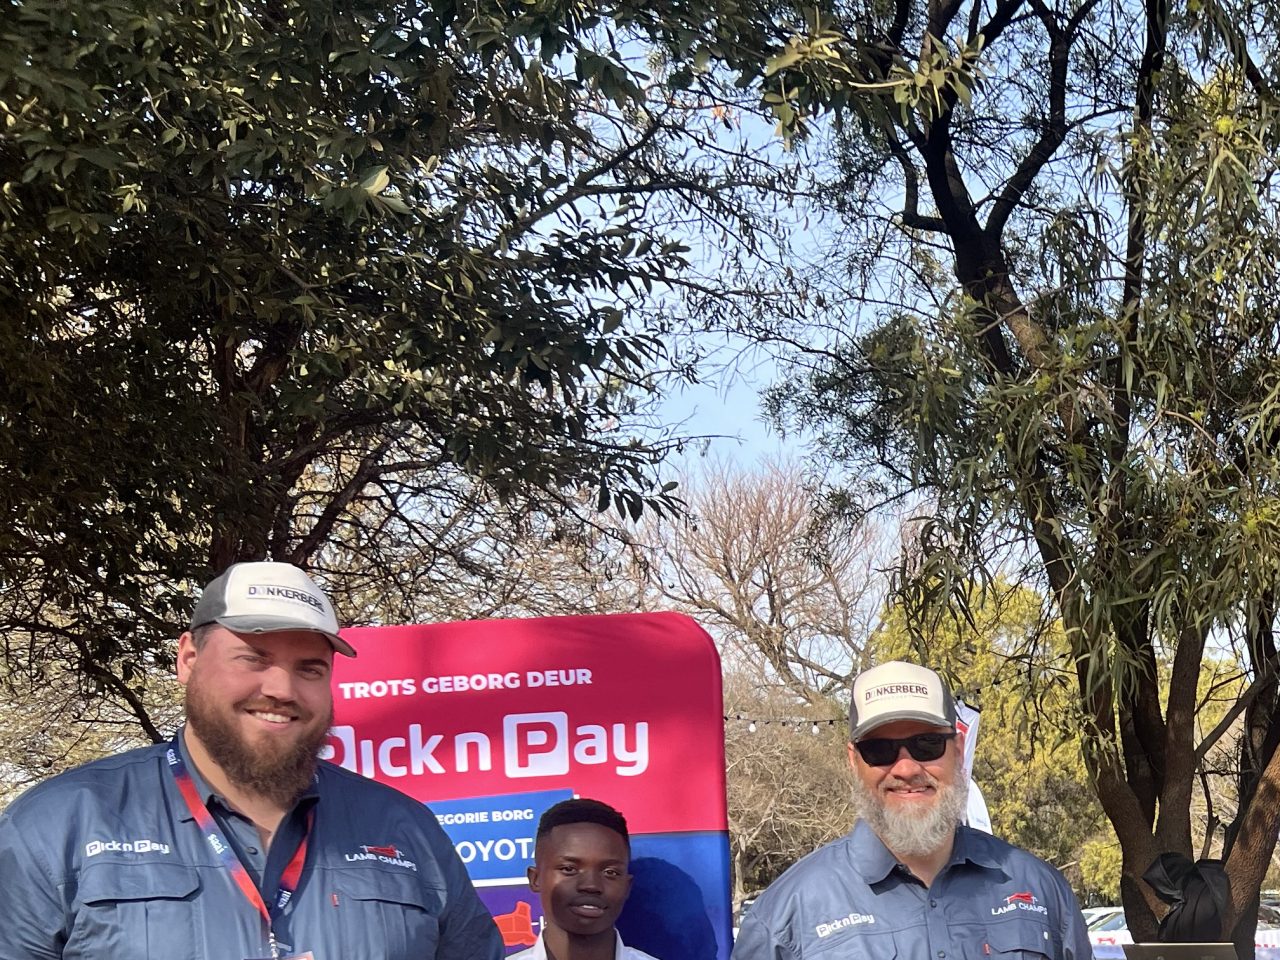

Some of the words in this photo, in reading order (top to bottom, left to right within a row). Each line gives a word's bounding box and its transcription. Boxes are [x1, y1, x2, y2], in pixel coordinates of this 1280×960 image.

[249, 586, 325, 613] DNKERBE
[338, 678, 416, 699] TROTS
[422, 672, 521, 694] GEBORG
[527, 668, 592, 688] DEUR
[454, 731, 492, 772] n
[503, 711, 649, 779] Pay
[435, 810, 489, 825] EGORIE
[492, 808, 534, 822] BORG
[86, 840, 121, 857] Pick
[121, 842, 133, 852] n
[134, 839, 170, 854] Pay
[207, 833, 228, 855] saai
[455, 837, 535, 863] OYOT
[345, 853, 377, 862] LAMB
[378, 855, 417, 871] CHAMPS
[991, 903, 1016, 915] LAMB
[1018, 902, 1048, 915] CHAMPS
[816, 918, 843, 938] Pick
[842, 917, 850, 928] n
[849, 913, 875, 925] Pay
